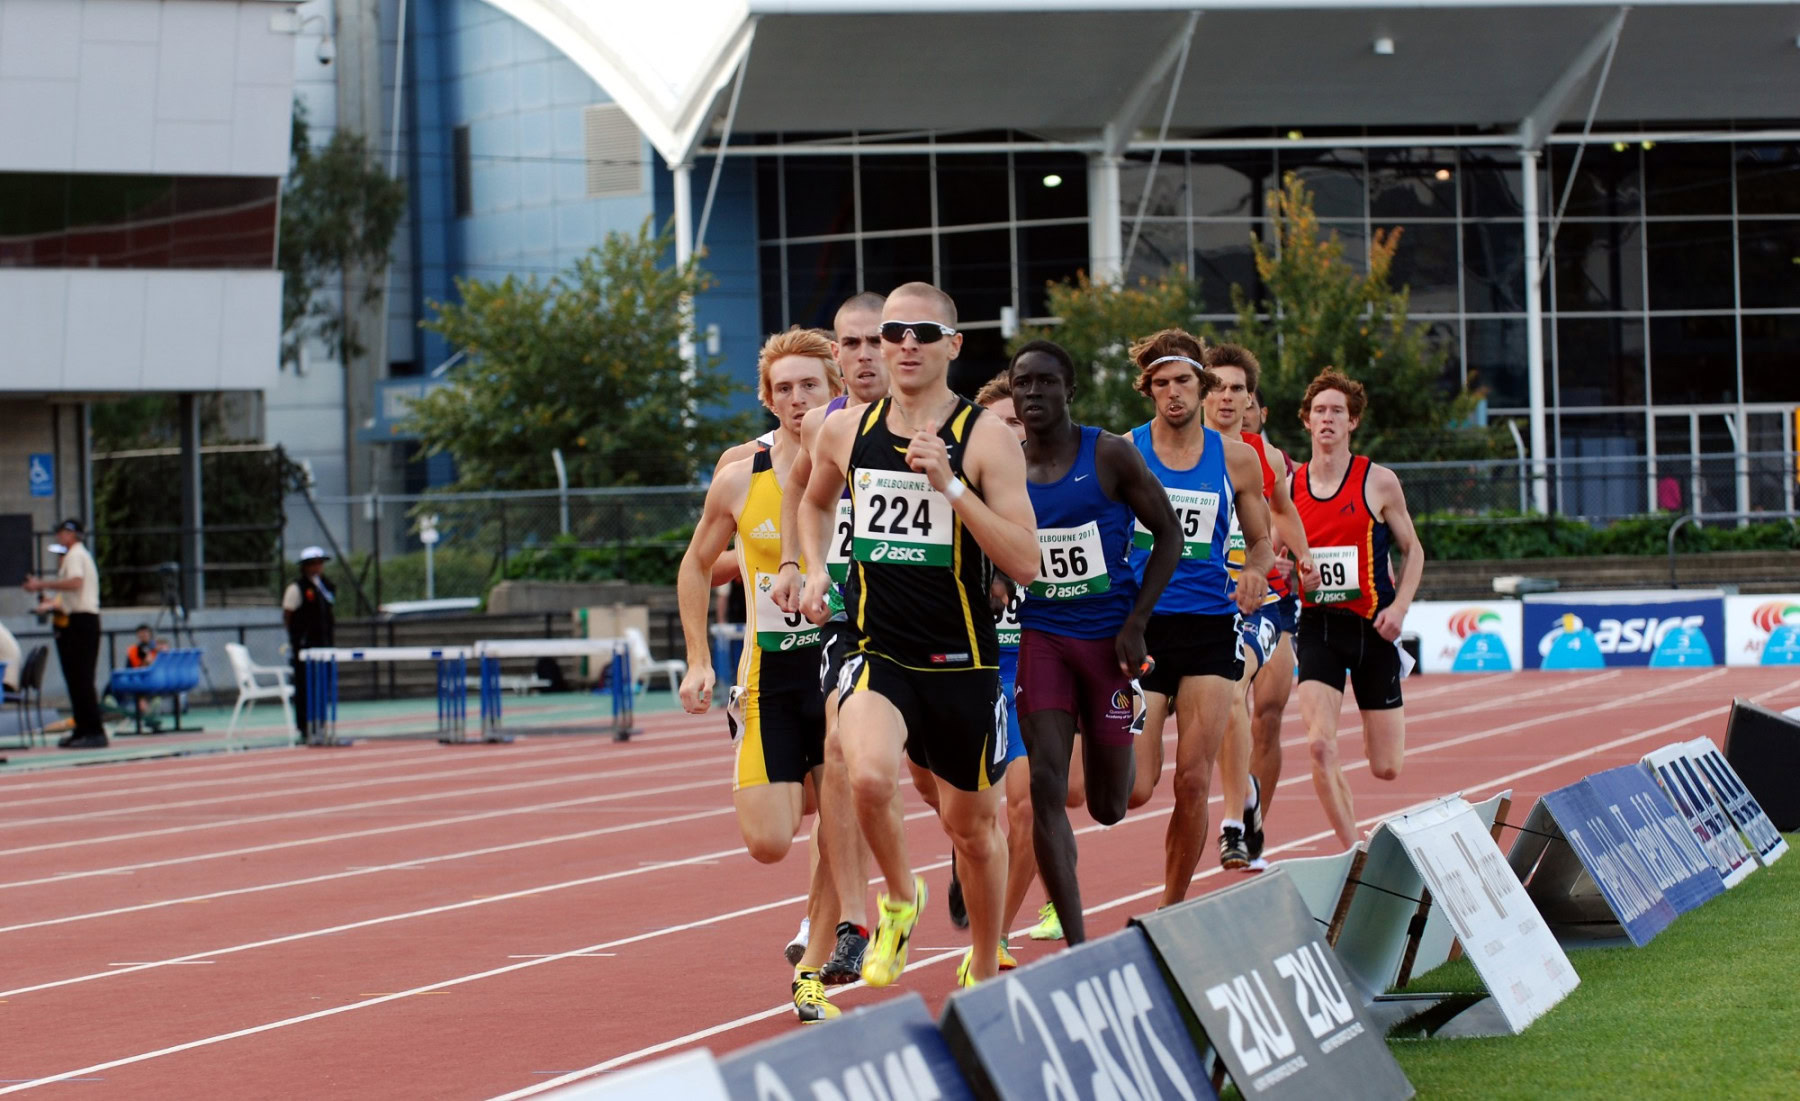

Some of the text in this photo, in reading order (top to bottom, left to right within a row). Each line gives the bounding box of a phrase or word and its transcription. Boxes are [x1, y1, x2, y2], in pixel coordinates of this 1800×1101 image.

[876, 478, 925, 491] MELBOURNE
[1200, 497, 1216, 506] 2011
[868, 494, 932, 536] 224
[1038, 528, 1095, 543] ELBOURNE 2011
[886, 545, 926, 562] asics
[1341, 550, 1355, 558] 2011
[1319, 562, 1346, 587] 69
[1057, 583, 1090, 598] asics
[1323, 592, 1347, 603] asics
[796, 631, 821, 646] asic
[1609, 793, 1691, 890] Herald
[1643, 791, 1710, 875] Sun
[1569, 819, 1651, 923] Herald
[1596, 816, 1664, 906] Sun
[1273, 941, 1355, 1039] 2XU
[1205, 969, 1297, 1076] 2XU
